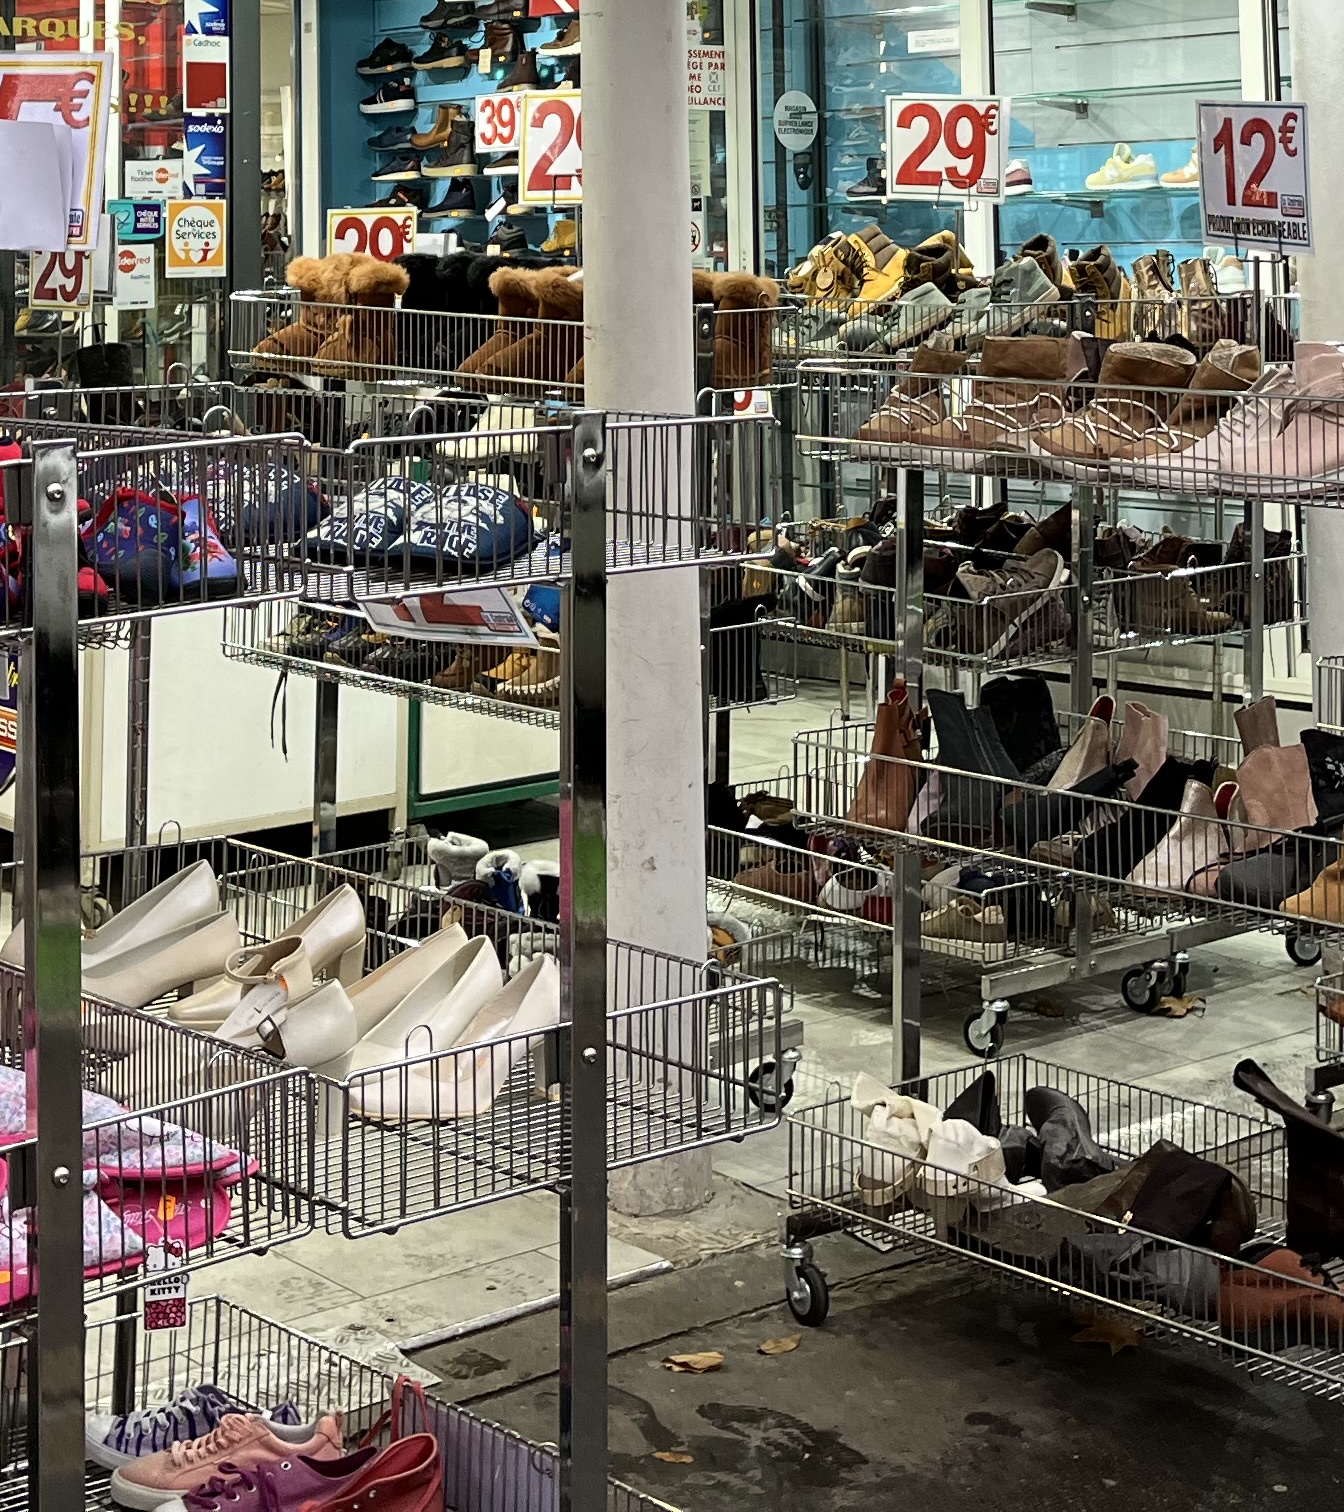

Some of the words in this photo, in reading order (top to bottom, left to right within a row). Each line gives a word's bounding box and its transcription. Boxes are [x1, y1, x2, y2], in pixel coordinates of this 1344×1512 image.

[687, 49, 726, 60] SSEMENT
[187, 118, 225, 134] sodexo
[526, 99, 582, 191] 2
[896, 102, 1000, 189] 29€
[1213, 112, 1298, 210] 12€
[177, 216, 215, 229] Chèque
[176, 229, 217, 240] Services
[150, 1285, 181, 1296] KITTY
